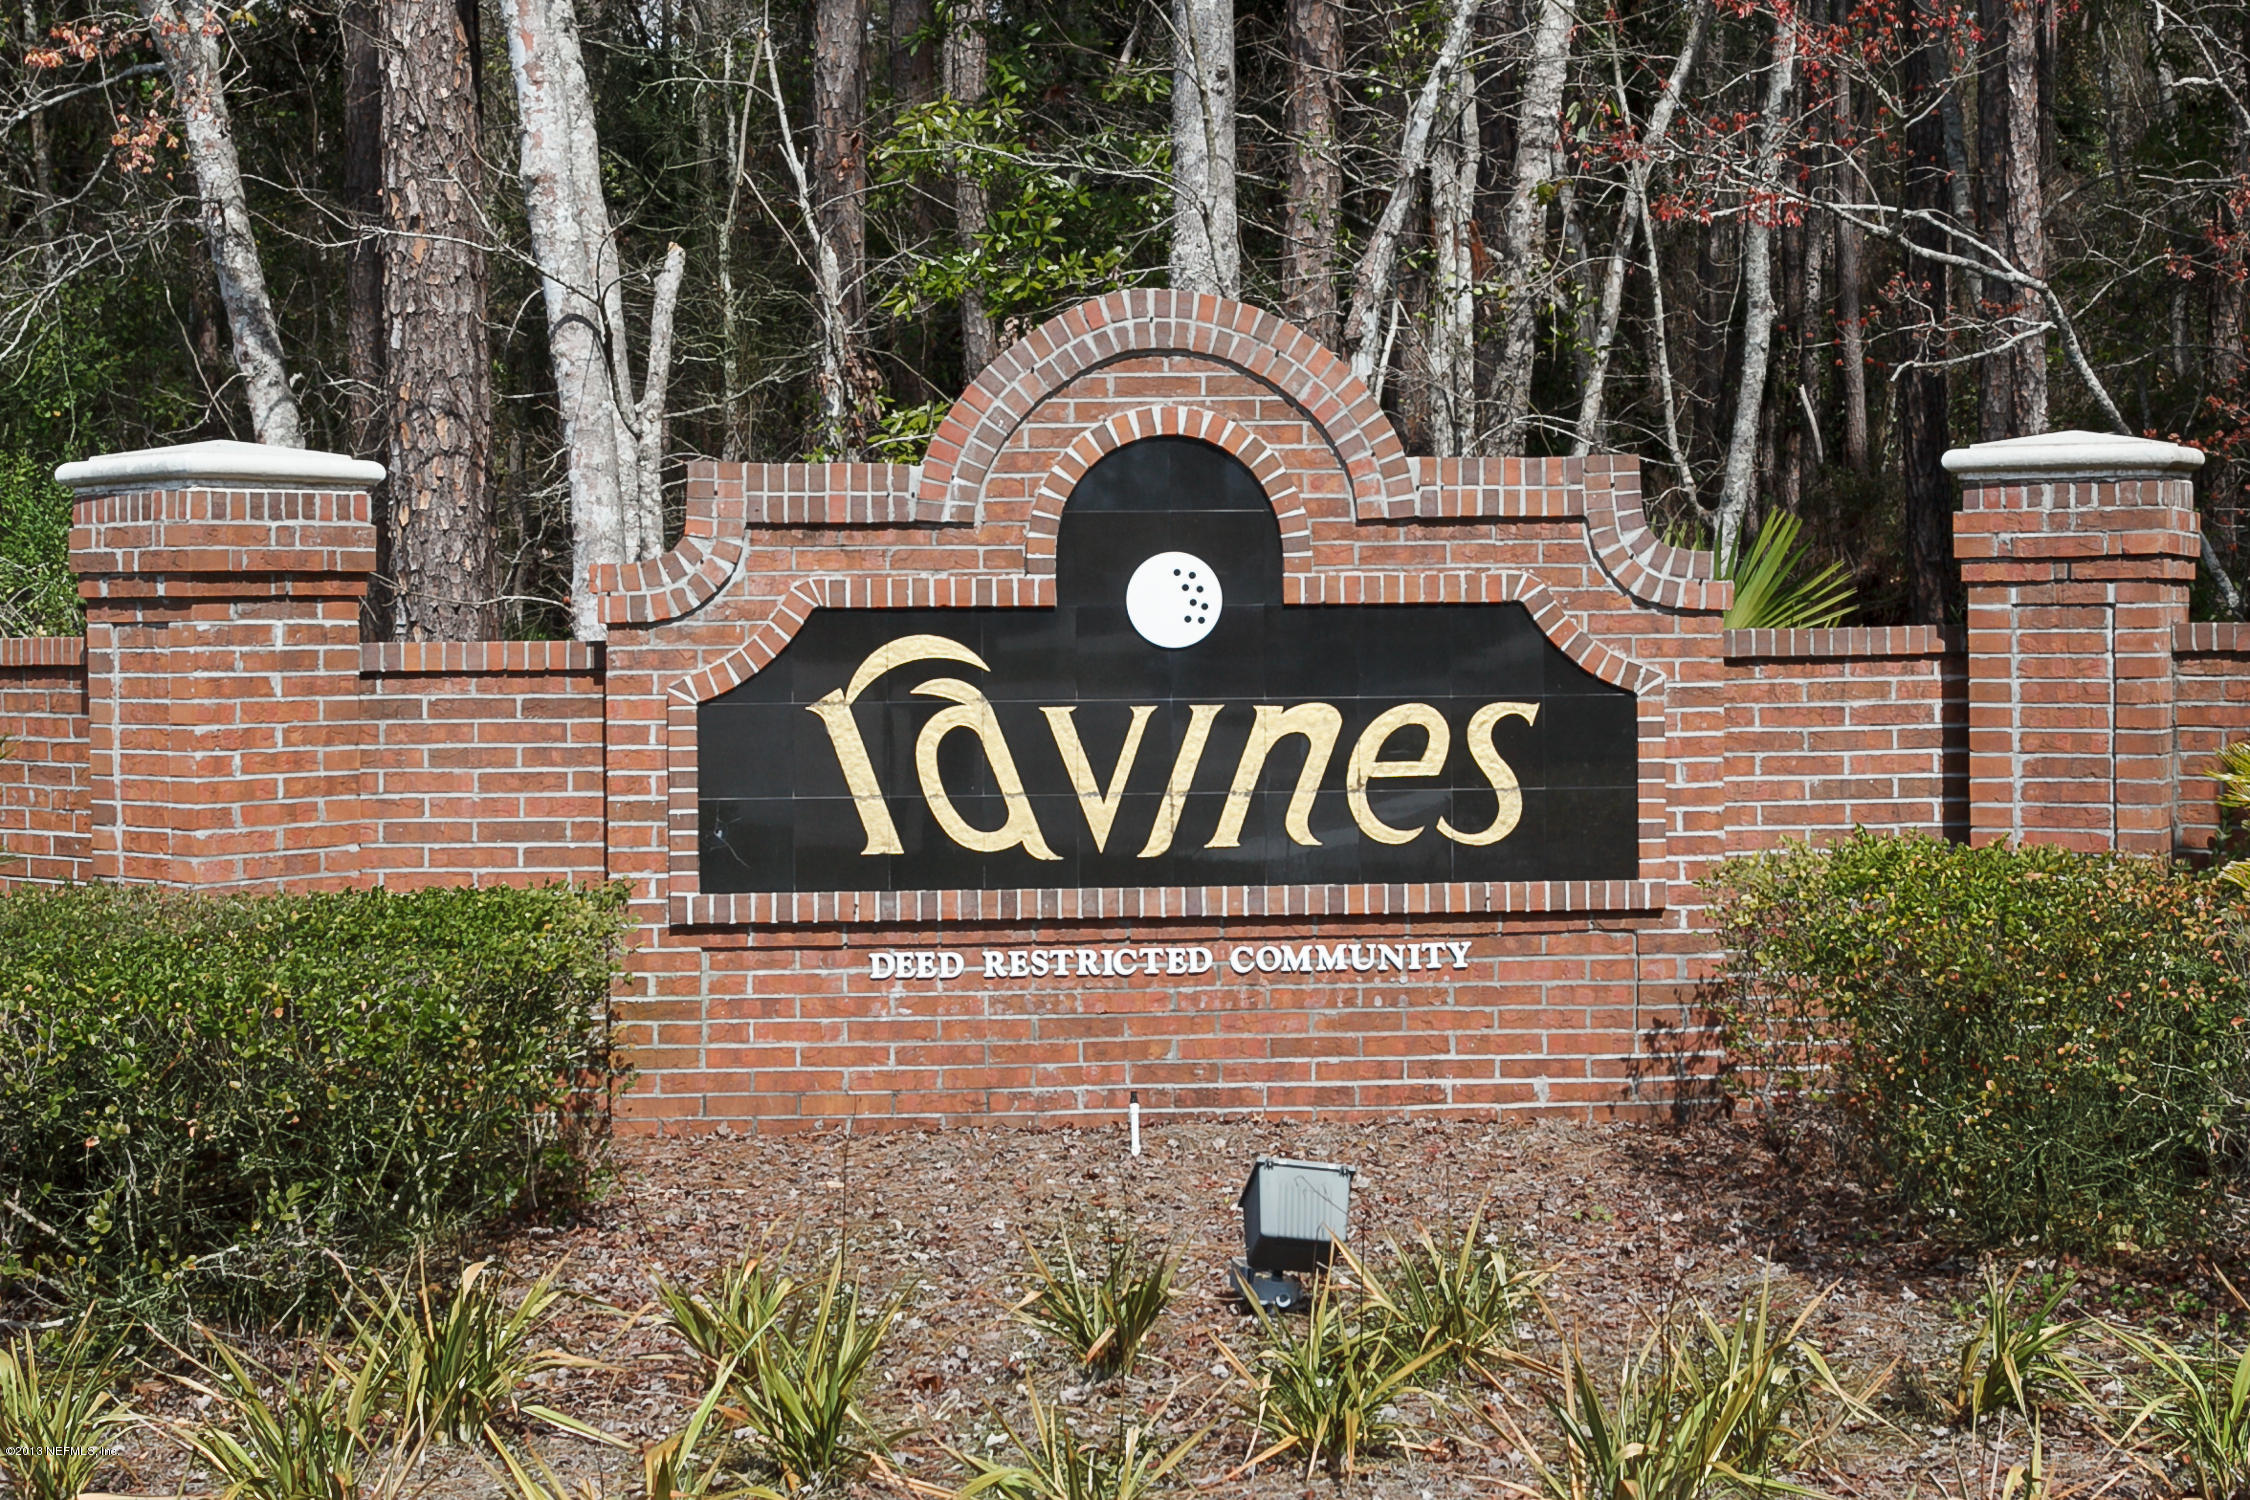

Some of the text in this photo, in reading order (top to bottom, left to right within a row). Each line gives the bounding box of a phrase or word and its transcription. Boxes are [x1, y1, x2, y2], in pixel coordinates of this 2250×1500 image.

[805, 634, 1540, 861] ravines
[868, 940, 1473, 979] DEED RESTRICTED COMMUNITY
